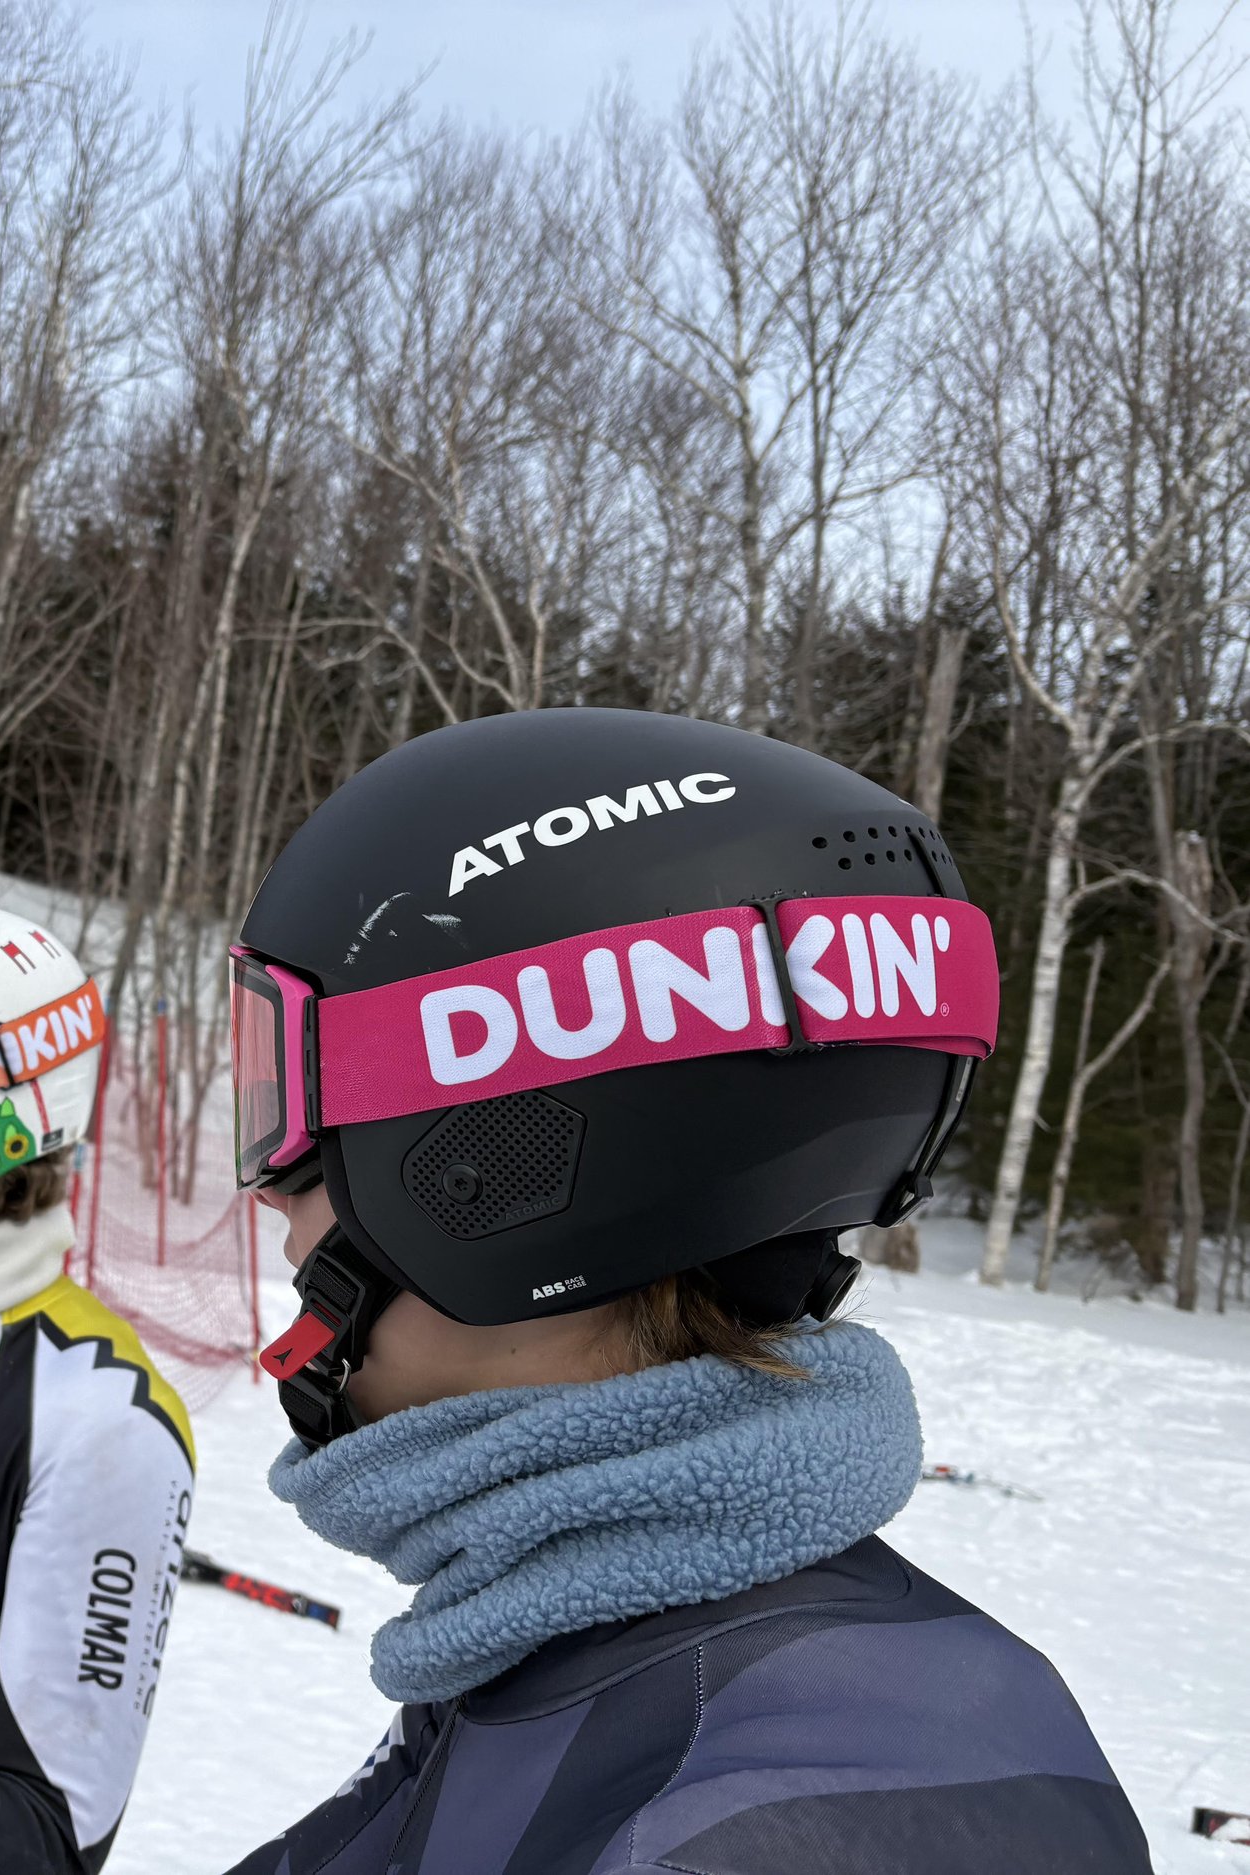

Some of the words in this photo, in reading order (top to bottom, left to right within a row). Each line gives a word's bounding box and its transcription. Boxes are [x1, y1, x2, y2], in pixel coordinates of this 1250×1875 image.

[448, 772, 736, 897] ATOMIC
[504, 1196, 560, 1222] ATOMIC
[532, 1281, 566, 1301] ABS
[564, 1274, 585, 1286] RACE
[567, 1280, 588, 1291] CASE
[77, 1548, 137, 1691] COLMAR
